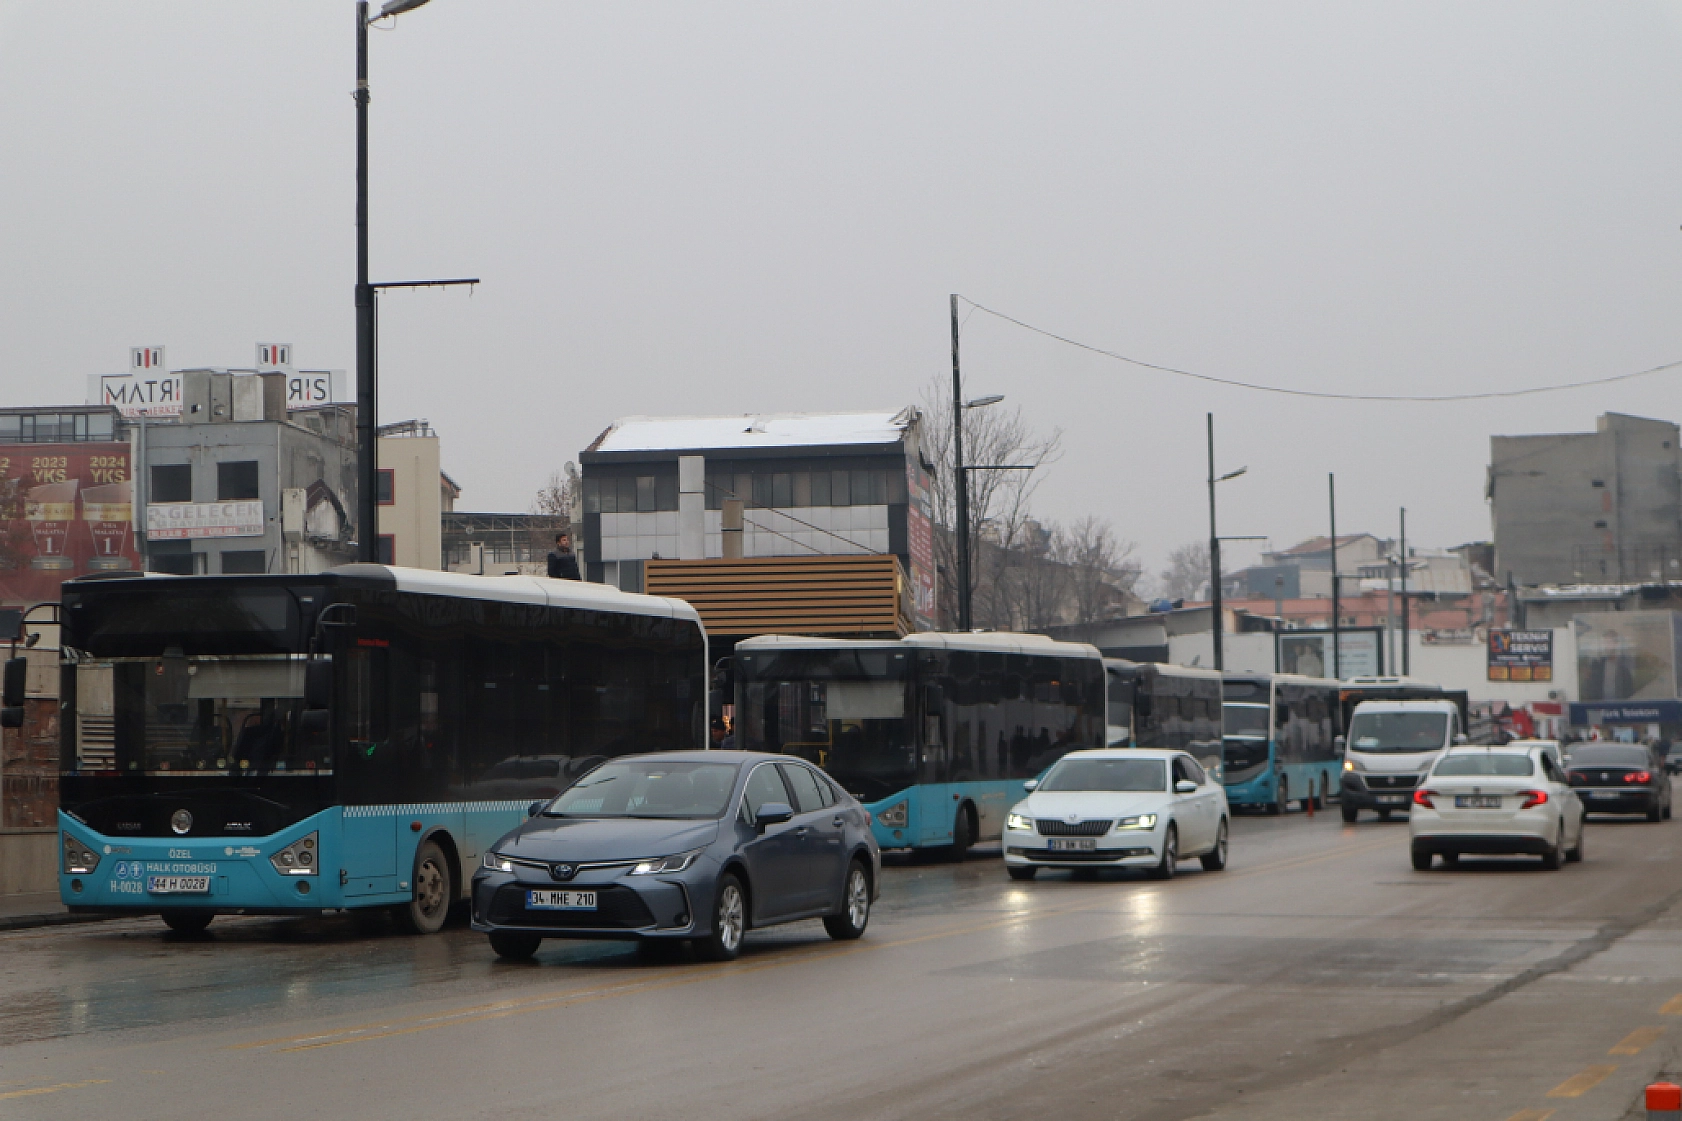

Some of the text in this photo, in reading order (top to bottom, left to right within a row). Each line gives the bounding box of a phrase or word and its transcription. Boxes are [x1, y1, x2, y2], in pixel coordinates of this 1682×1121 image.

[105, 379, 181, 405] MATRI
[32, 457, 68, 468] 2023
[89, 456, 126, 468] 2024
[33, 469, 67, 483] YKS
[89, 468, 125, 483] YKS
[168, 504, 261, 519] GELECEK
[169, 848, 192, 859] ÖZEL
[147, 863, 217, 873] HALK OTOBÜSÜ
[111, 881, 143, 893] H-0028
[154, 879, 206, 889] 44 H 0028
[533, 892, 594, 906] 34 MHE 210
